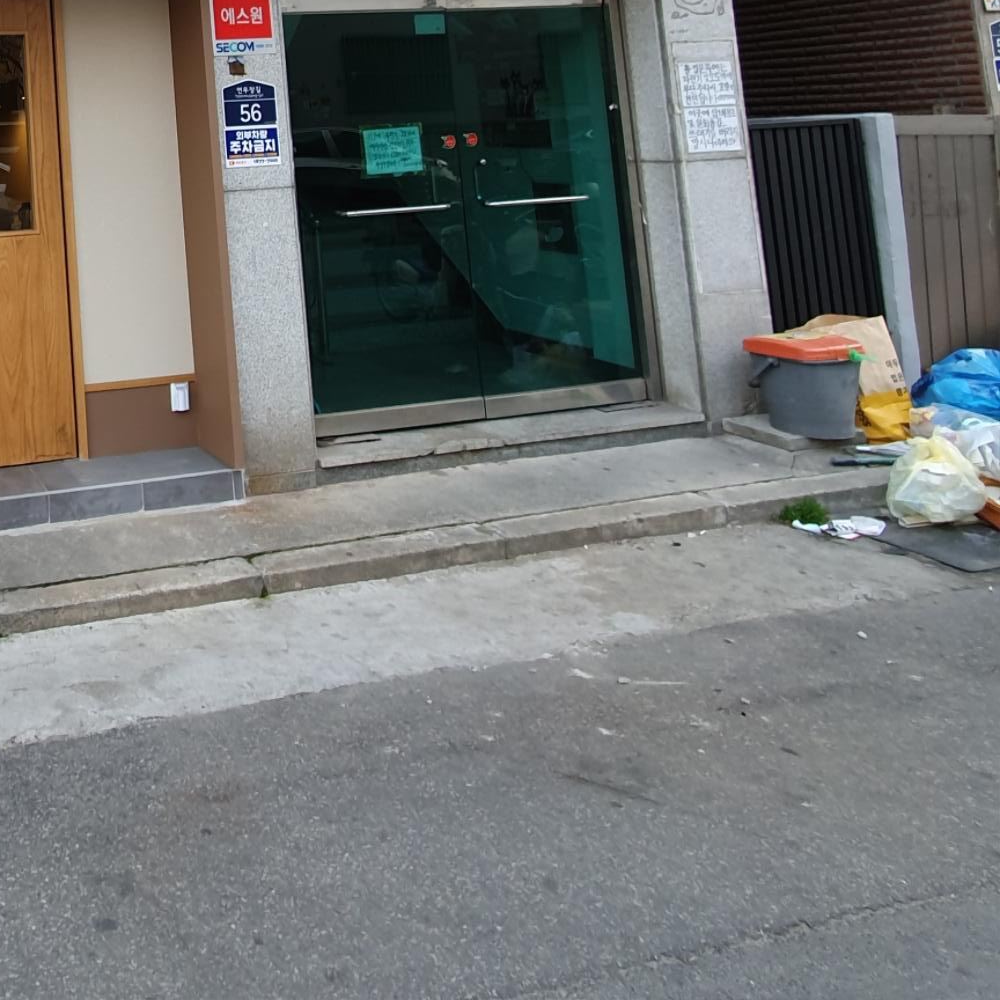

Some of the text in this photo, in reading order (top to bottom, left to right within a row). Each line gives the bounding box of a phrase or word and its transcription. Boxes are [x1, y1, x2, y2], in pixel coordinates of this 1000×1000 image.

[220, 6, 263, 25] 에스원
[216, 41, 255, 53] SECOM
[240, 103, 262, 122] 56
[236, 130, 268, 140] 외부차량
[229, 139, 276, 154] 주차금지
